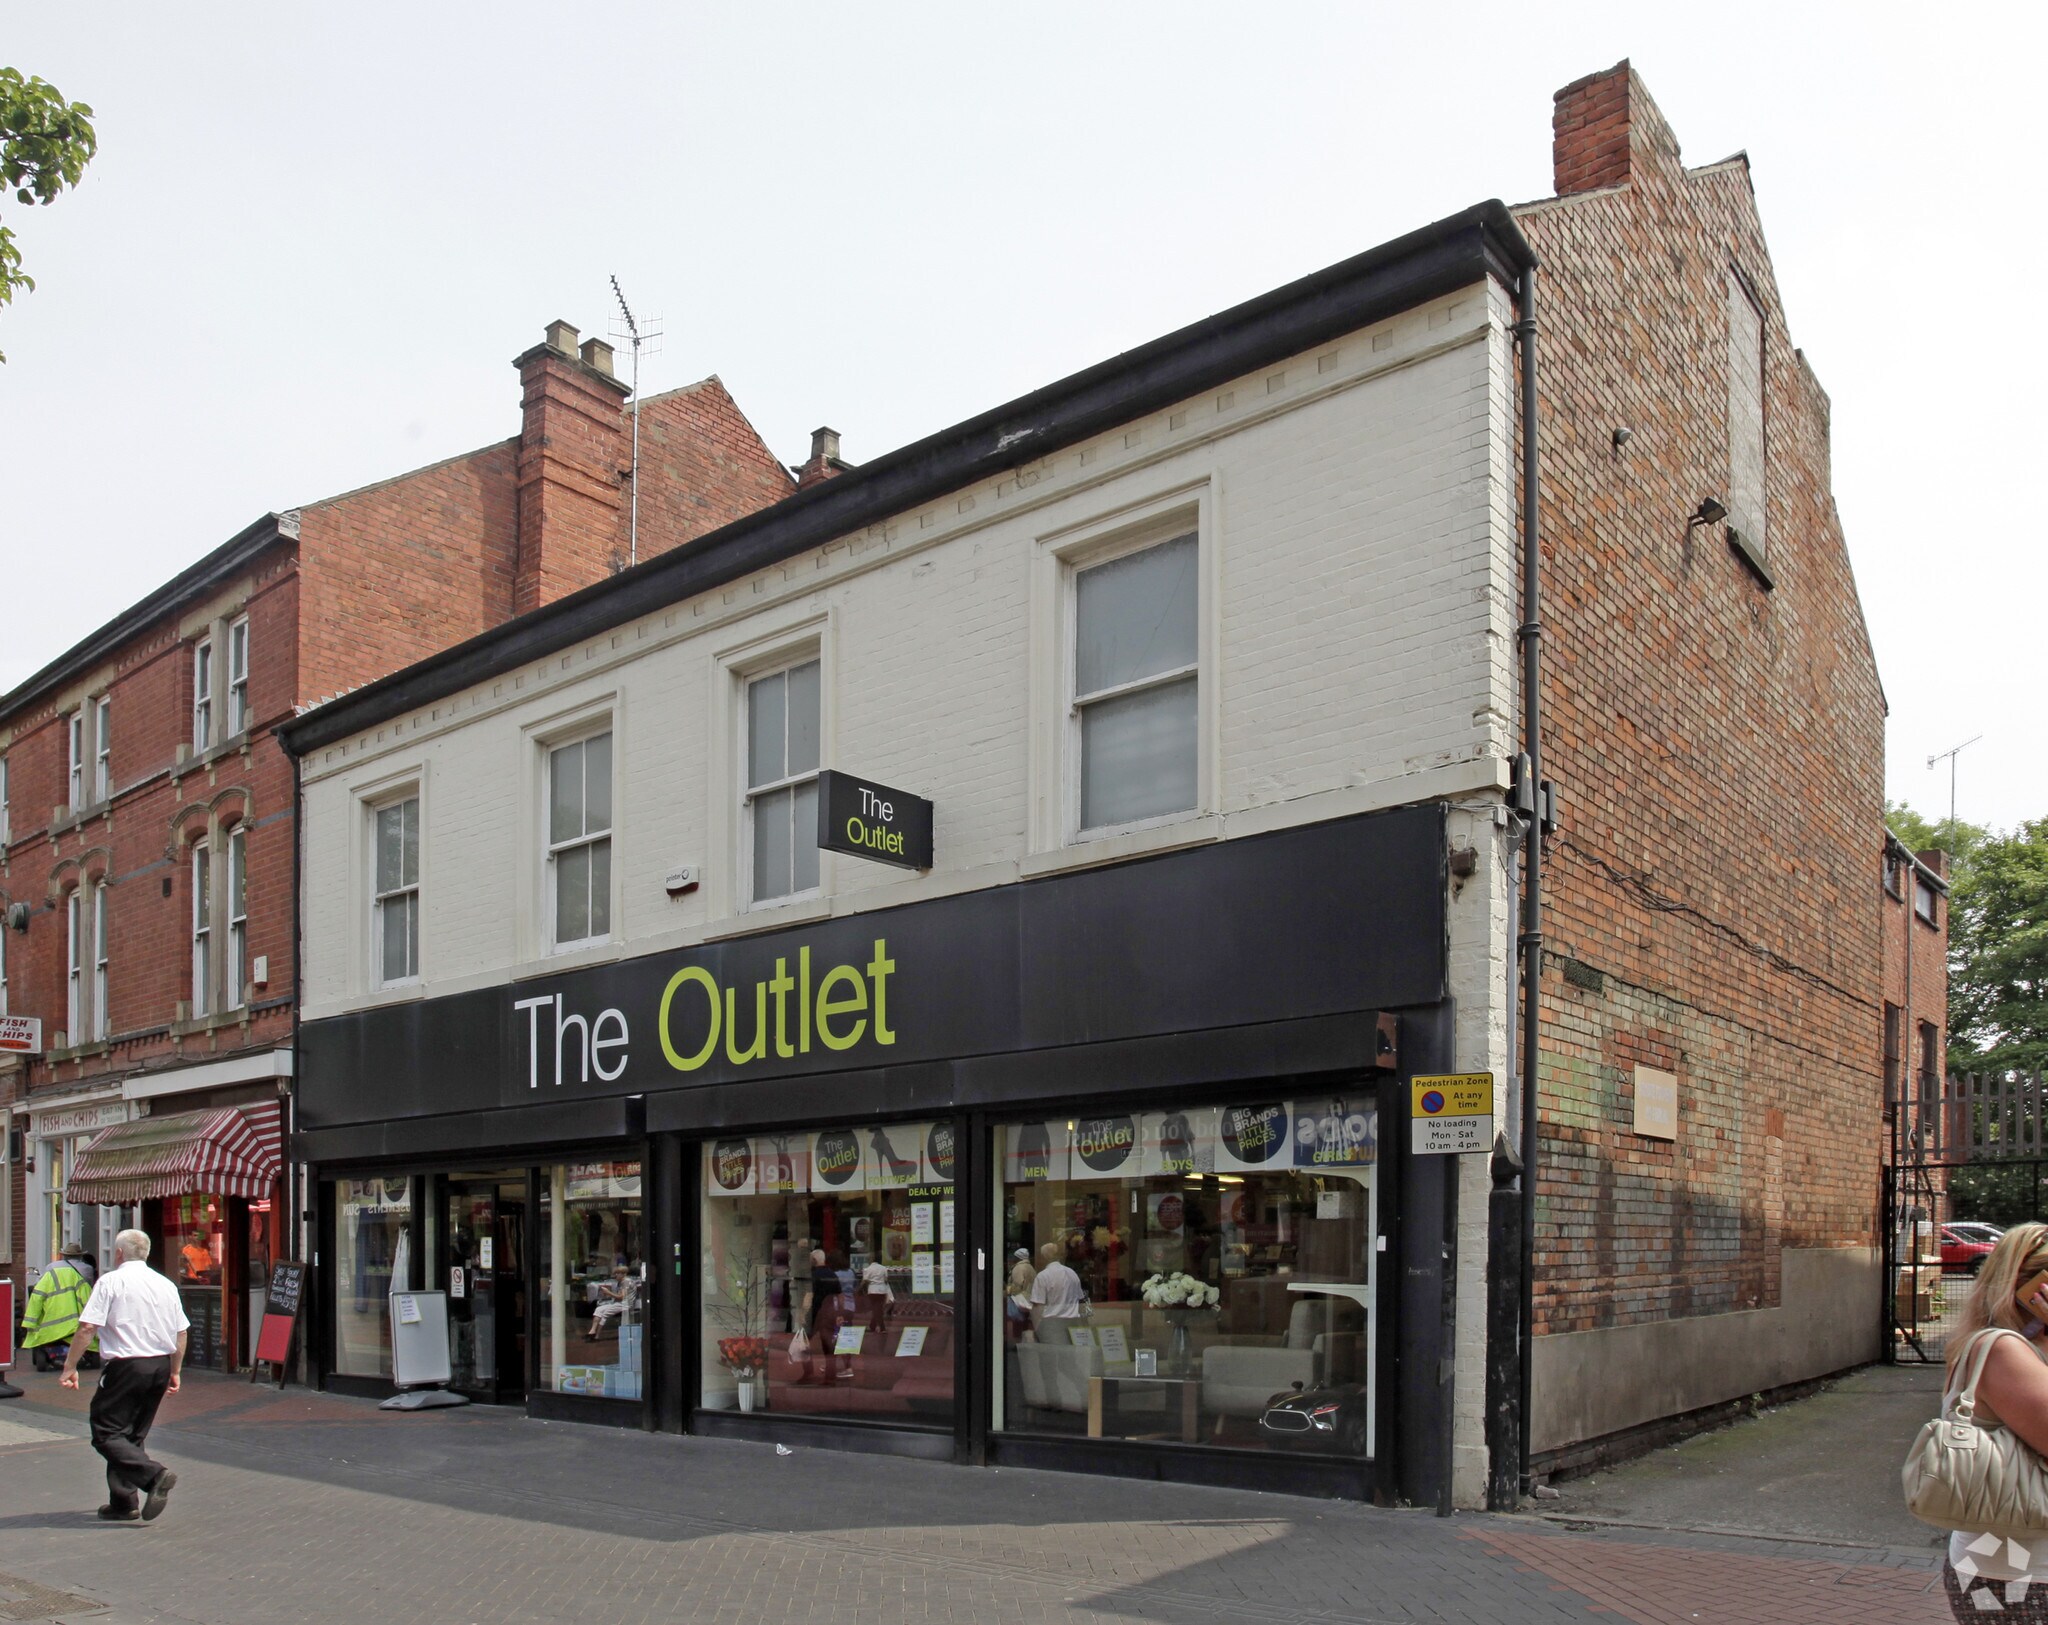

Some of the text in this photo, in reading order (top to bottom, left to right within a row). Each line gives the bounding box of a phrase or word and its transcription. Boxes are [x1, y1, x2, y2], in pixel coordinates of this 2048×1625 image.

[858, 787, 894, 822] The
[846, 816, 904, 856] Outlet
[514, 938, 896, 1089] The Outlet
[0, 1018, 28, 1028] FISH
[1415, 1077, 1489, 1088] Pedestrian Zone
[1466, 1092, 1483, 1100] any
[102, 1104, 123, 1115] EAT IN
[1458, 1100, 1478, 1109] time
[42, 1115, 60, 1132] FISH
[61, 1116, 73, 1127] AND
[73, 1109, 98, 1128] CHIPS
[1231, 1107, 1251, 1122] BIG
[1234, 1107, 1279, 1132] BRANDS
[1089, 1119, 1114, 1134] The
[1428, 1119, 1477, 1129] No loading
[934, 1130, 949, 1144] BIG
[1236, 1121, 1273, 1142] LITTLE
[1431, 1131, 1451, 1139] Mon
[1458, 1130, 1474, 1138] Sat
[824, 1138, 844, 1153] The
[1080, 1125, 1133, 1158] Outlet
[1238, 1130, 1277, 1152] PRICES
[1466, 1142, 1480, 1150] pm
[718, 1145, 730, 1158] BIG
[719, 1147, 746, 1165] BRANDS
[1312, 1149, 1352, 1163] GIRLS
[818, 1145, 858, 1174] Outlet
[1161, 1158, 1195, 1171] BOYS
[1024, 1166, 1049, 1178] MEN
[868, 1173, 918, 1186] FOOTWEAR
[908, 1187, 929, 1197] DEAL
[930, 1186, 942, 1196] OF
